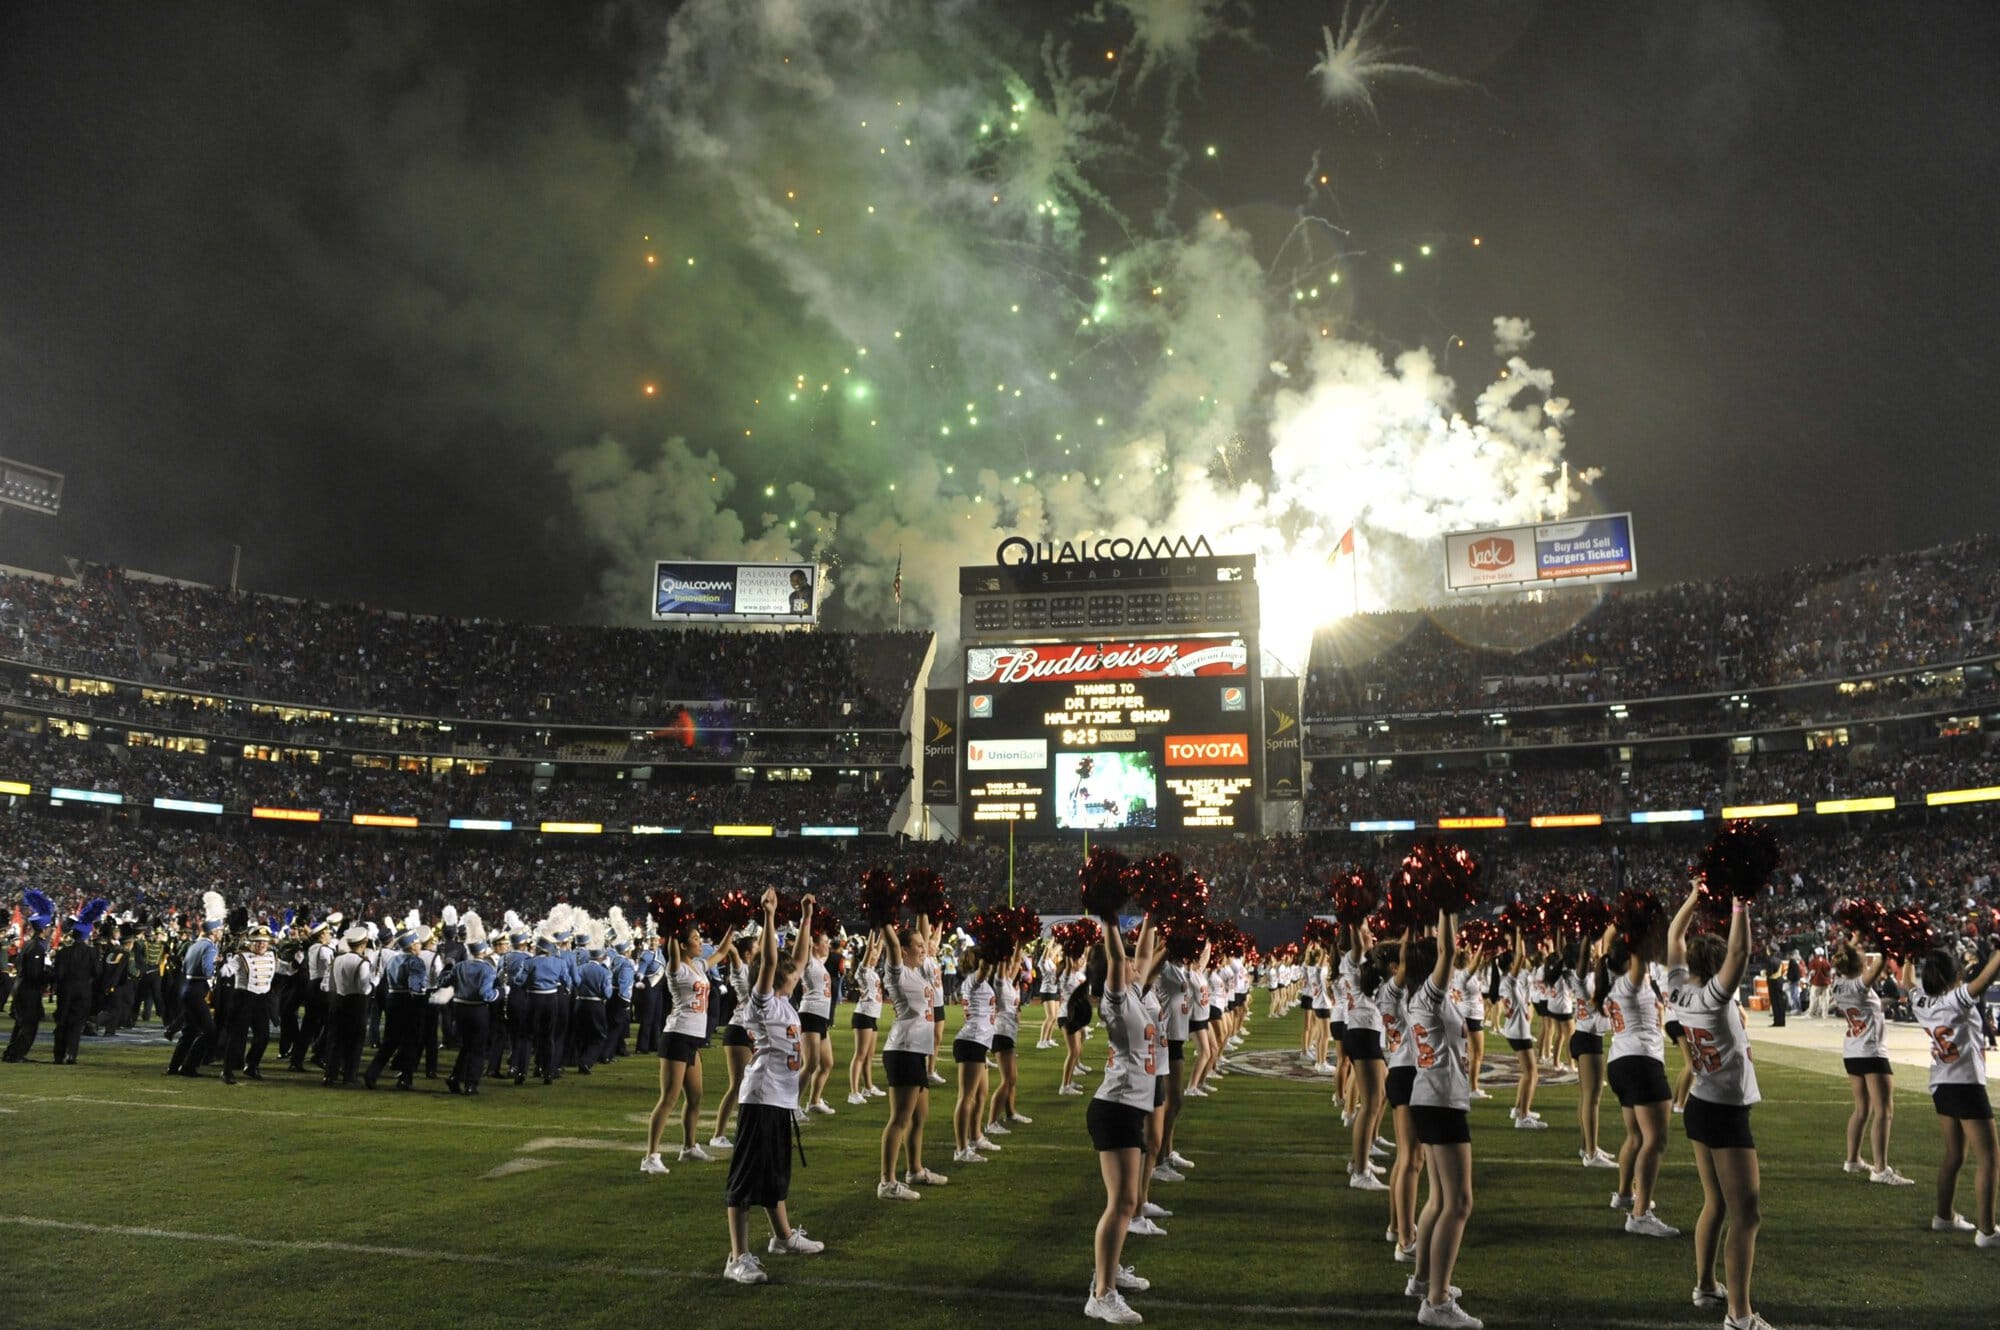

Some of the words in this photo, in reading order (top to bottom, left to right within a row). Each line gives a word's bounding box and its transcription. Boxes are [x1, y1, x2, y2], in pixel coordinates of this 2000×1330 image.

[997, 534, 1214, 567] QUALCOMM
[1470, 540, 1513, 568] Jack
[1554, 542, 1571, 553] Buy
[1574, 540, 1591, 550] and
[1543, 552, 1585, 565] Chargers
[1587, 547, 1624, 560] Tickets!
[1042, 566, 1198, 582] STADIUM
[662, 578, 734, 594] QUALCOMM
[739, 587, 789, 595] HEALTH
[992, 642, 1180, 684] Budweiser
[1074, 684, 1116, 695] THANKS
[1119, 683, 1135, 694] TO
[1064, 697, 1085, 710] DR
[1090, 695, 1144, 709] PEPPER
[1044, 710, 1122, 725] HALFTIME
[1130, 709, 1170, 723] SHOW
[924, 744, 955, 757] Sprint
[1168, 742, 1245, 759] TOYOTA
[1266, 738, 1299, 750] Sprint
